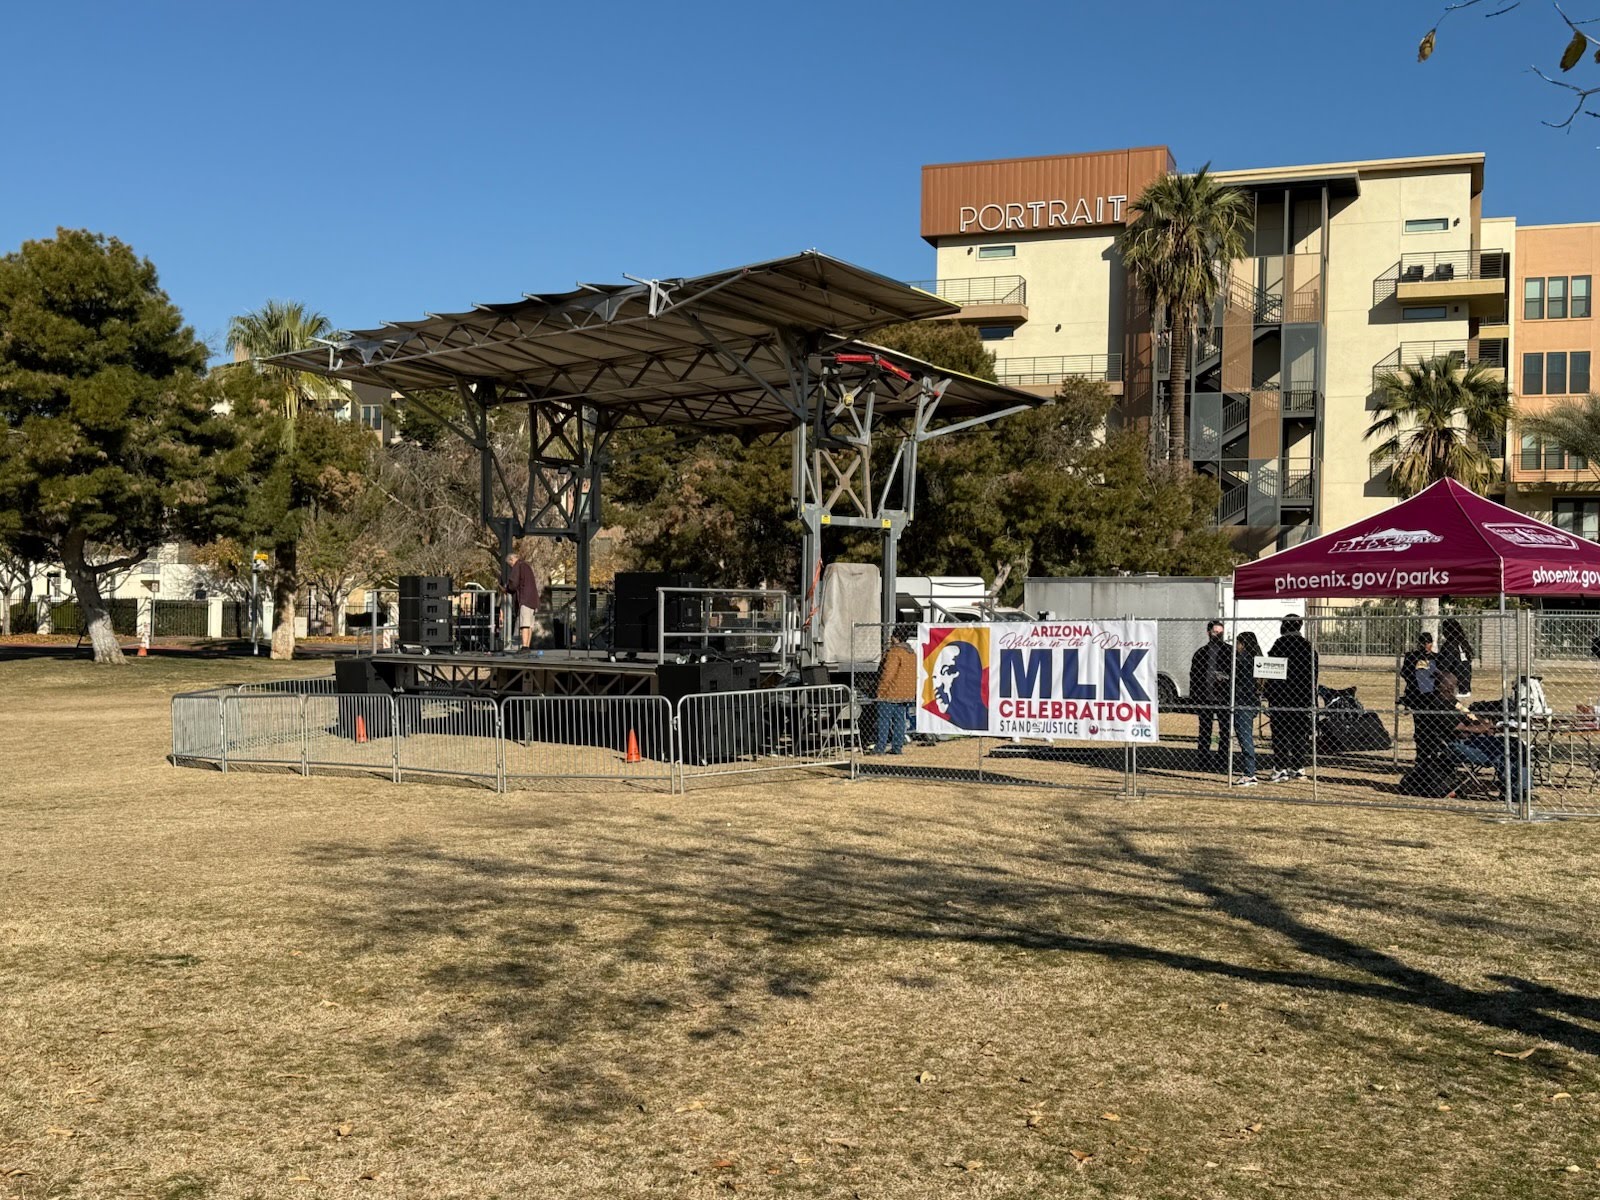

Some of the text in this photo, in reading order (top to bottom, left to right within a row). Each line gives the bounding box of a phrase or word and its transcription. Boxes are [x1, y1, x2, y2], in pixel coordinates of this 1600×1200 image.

[959, 195, 1127, 232] PORTRAIT
[1274, 567, 1450, 593] phoenix.gov/parks
[999, 631, 1152, 649] Believe in the Dream
[1031, 625, 1092, 637] ARIZONA
[1000, 648, 1151, 701] MLK
[999, 700, 1152, 722] CELEBRATION
[1000, 719, 1031, 733] STAND
[1041, 720, 1078, 734] JUSTICE
[1131, 728, 1151, 737] OIC
